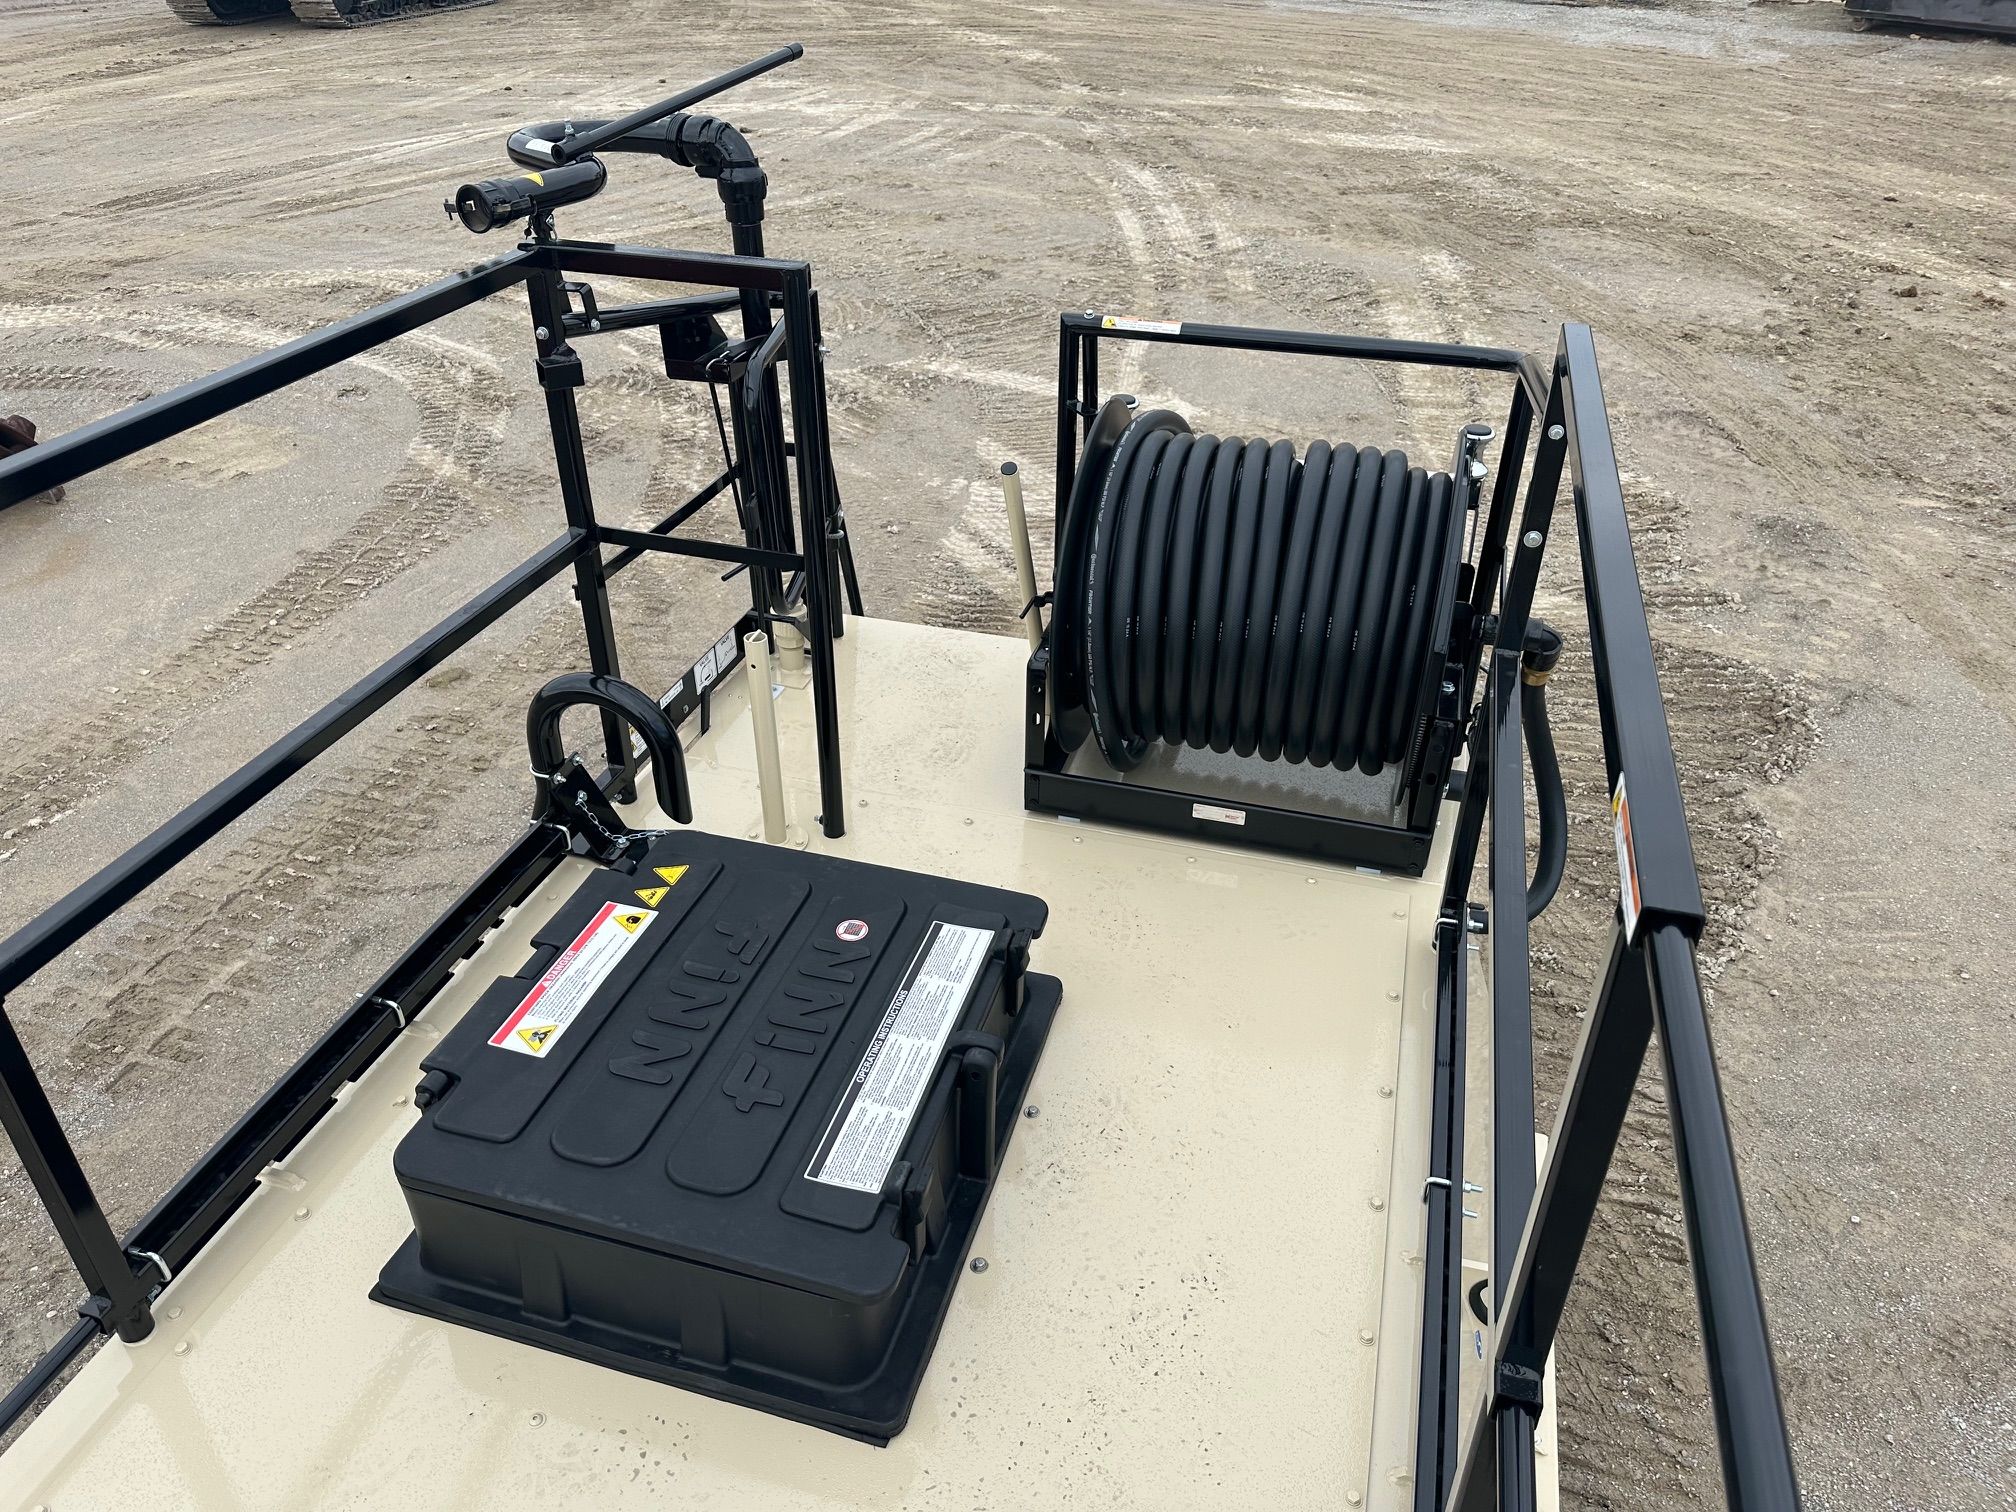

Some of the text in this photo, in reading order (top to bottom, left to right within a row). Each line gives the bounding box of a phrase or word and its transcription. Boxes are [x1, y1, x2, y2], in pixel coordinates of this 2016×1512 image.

[545, 949, 578, 982] DANGER
[856, 989, 909, 1084] OPERATING INSTRUCTIONS
